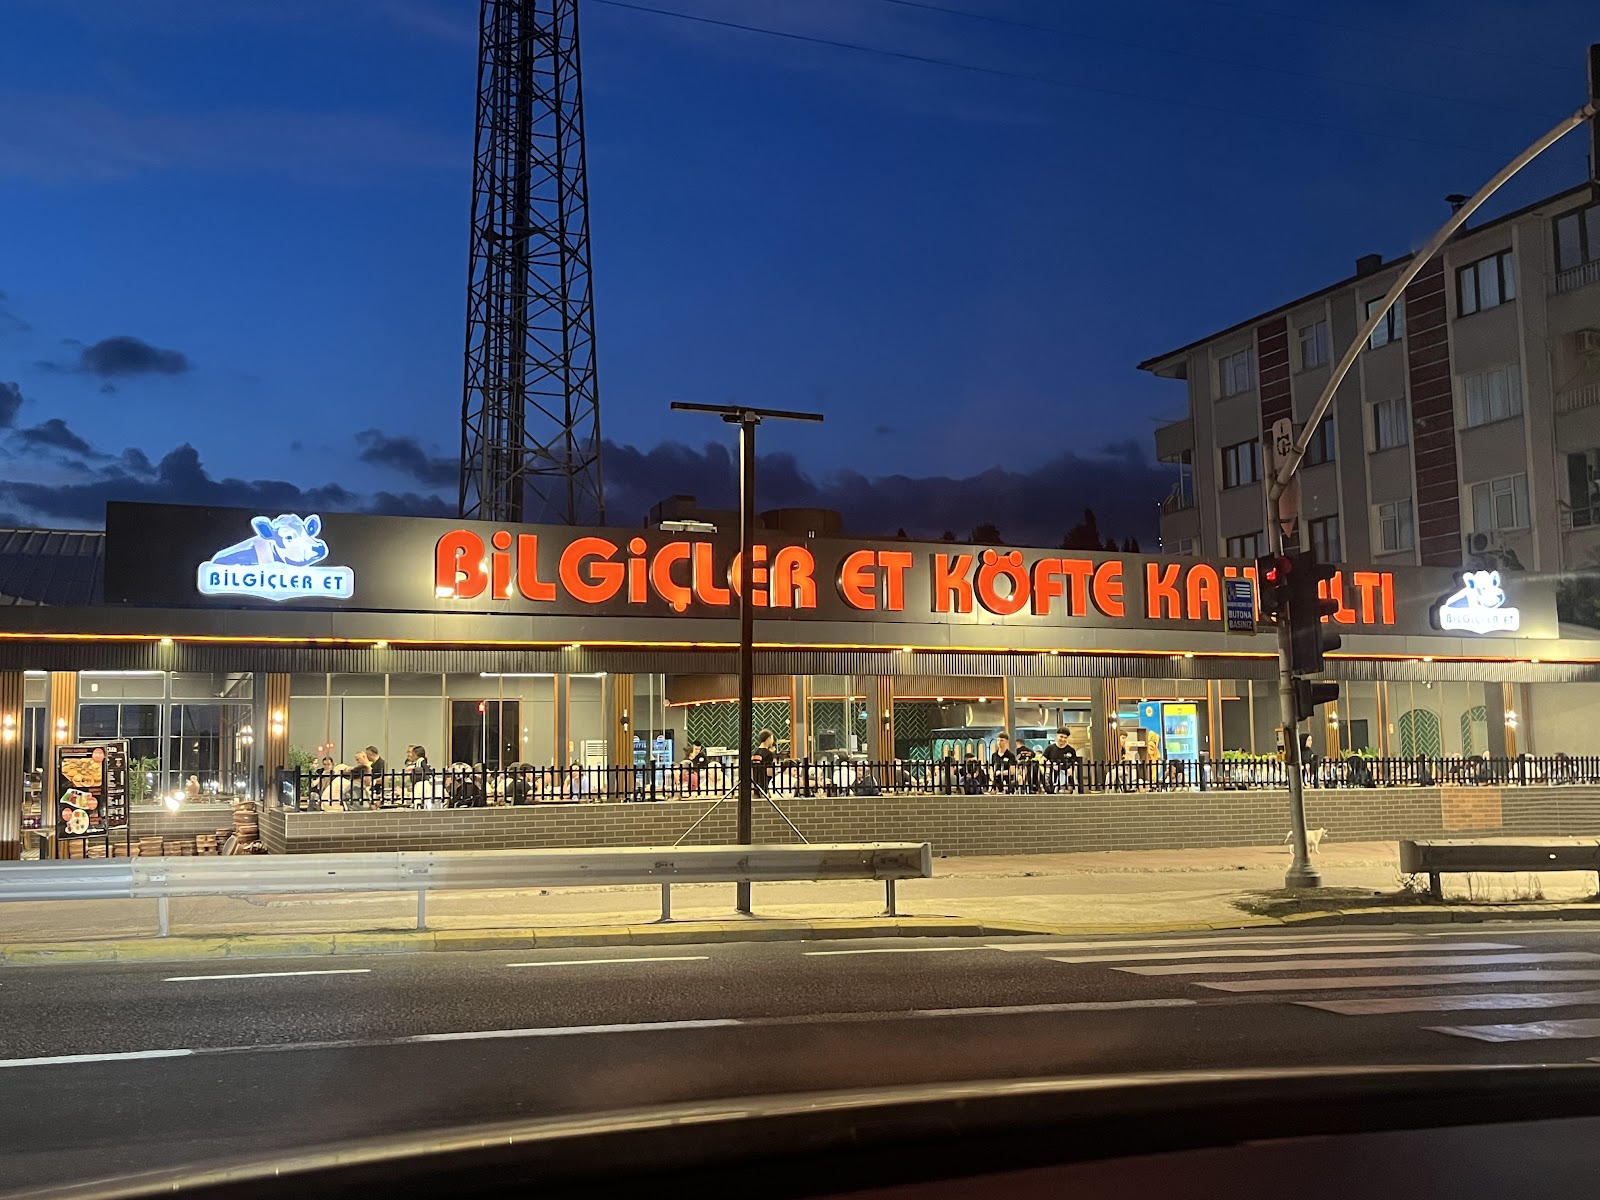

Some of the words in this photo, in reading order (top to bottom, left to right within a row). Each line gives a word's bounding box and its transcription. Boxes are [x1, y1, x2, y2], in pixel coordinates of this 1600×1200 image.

[209, 569, 313, 590] BİLGİÇLER
[323, 576, 343, 590] ET
[435, 529, 817, 613] BİLGİÇLER
[841, 550, 913, 611] ET
[934, 548, 1125, 617] KÖFTE
[1146, 562, 1396, 625] KALTI
[1228, 610, 1252, 619] BUTONA
